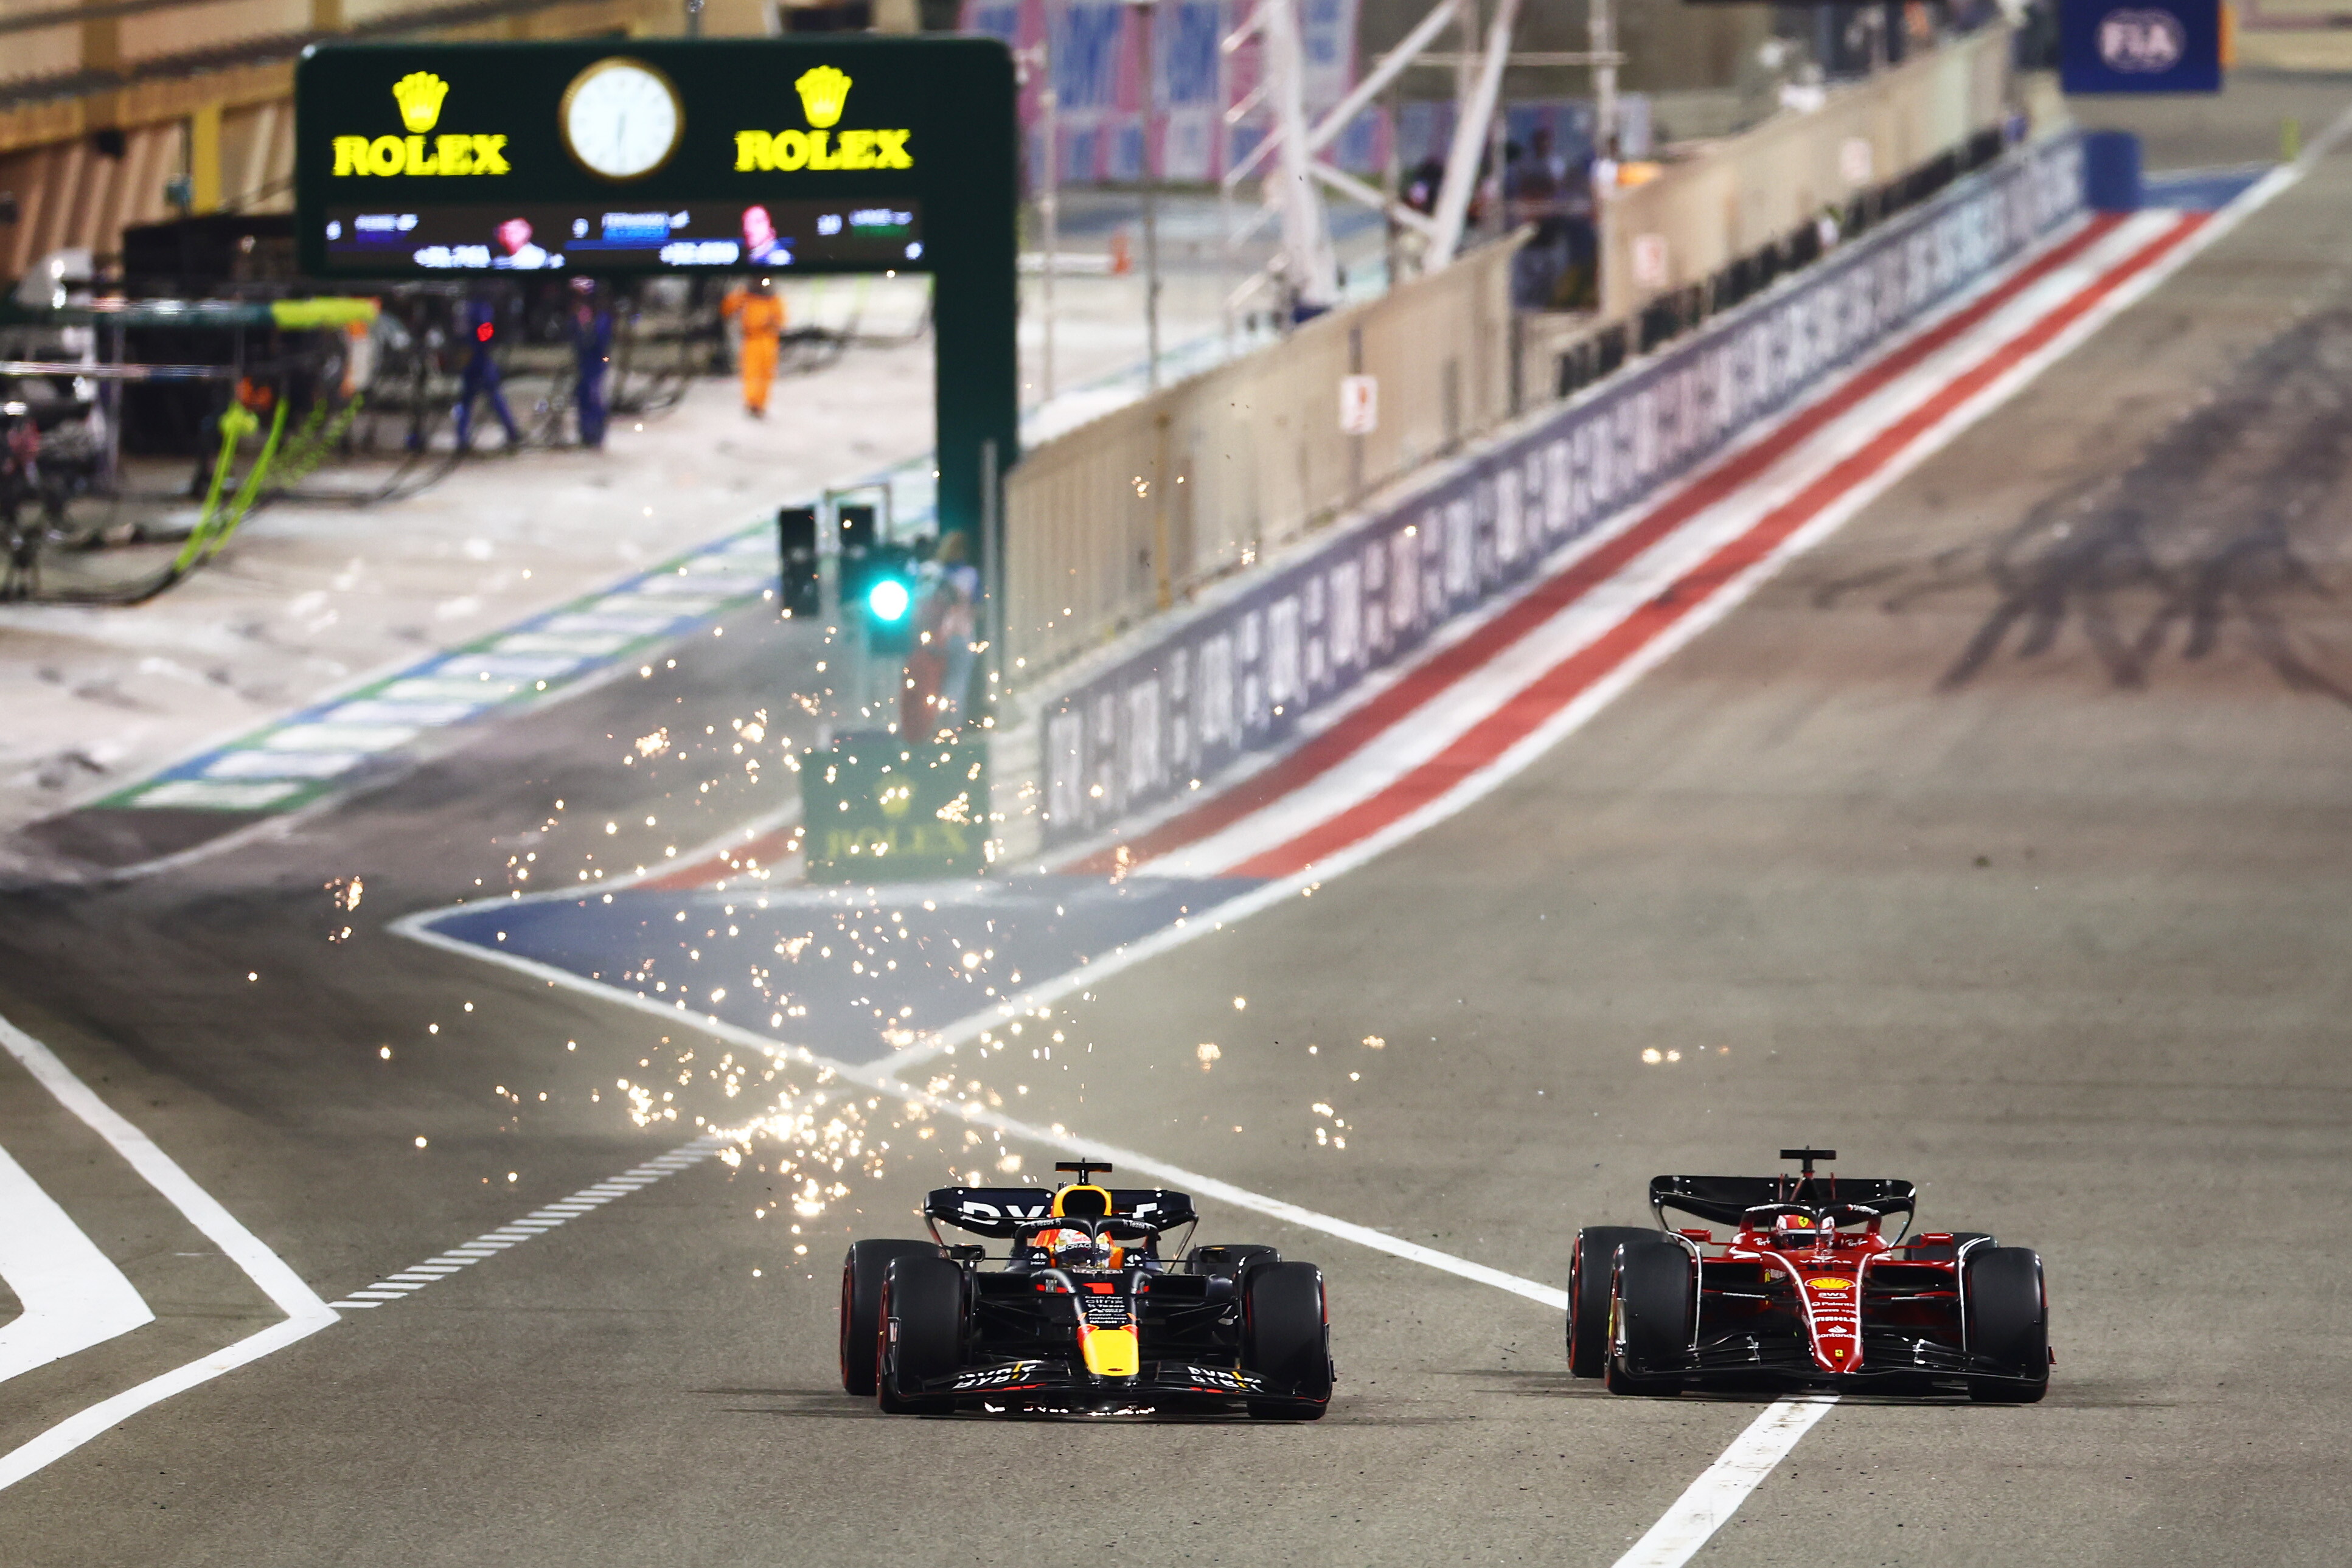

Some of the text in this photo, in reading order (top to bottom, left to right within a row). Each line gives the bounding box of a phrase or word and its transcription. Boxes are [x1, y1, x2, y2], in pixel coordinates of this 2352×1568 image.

[332, 133, 511, 176] ROLEX
[734, 127, 914, 173] ROLEX
[1082, 1282, 1115, 1294] 1
